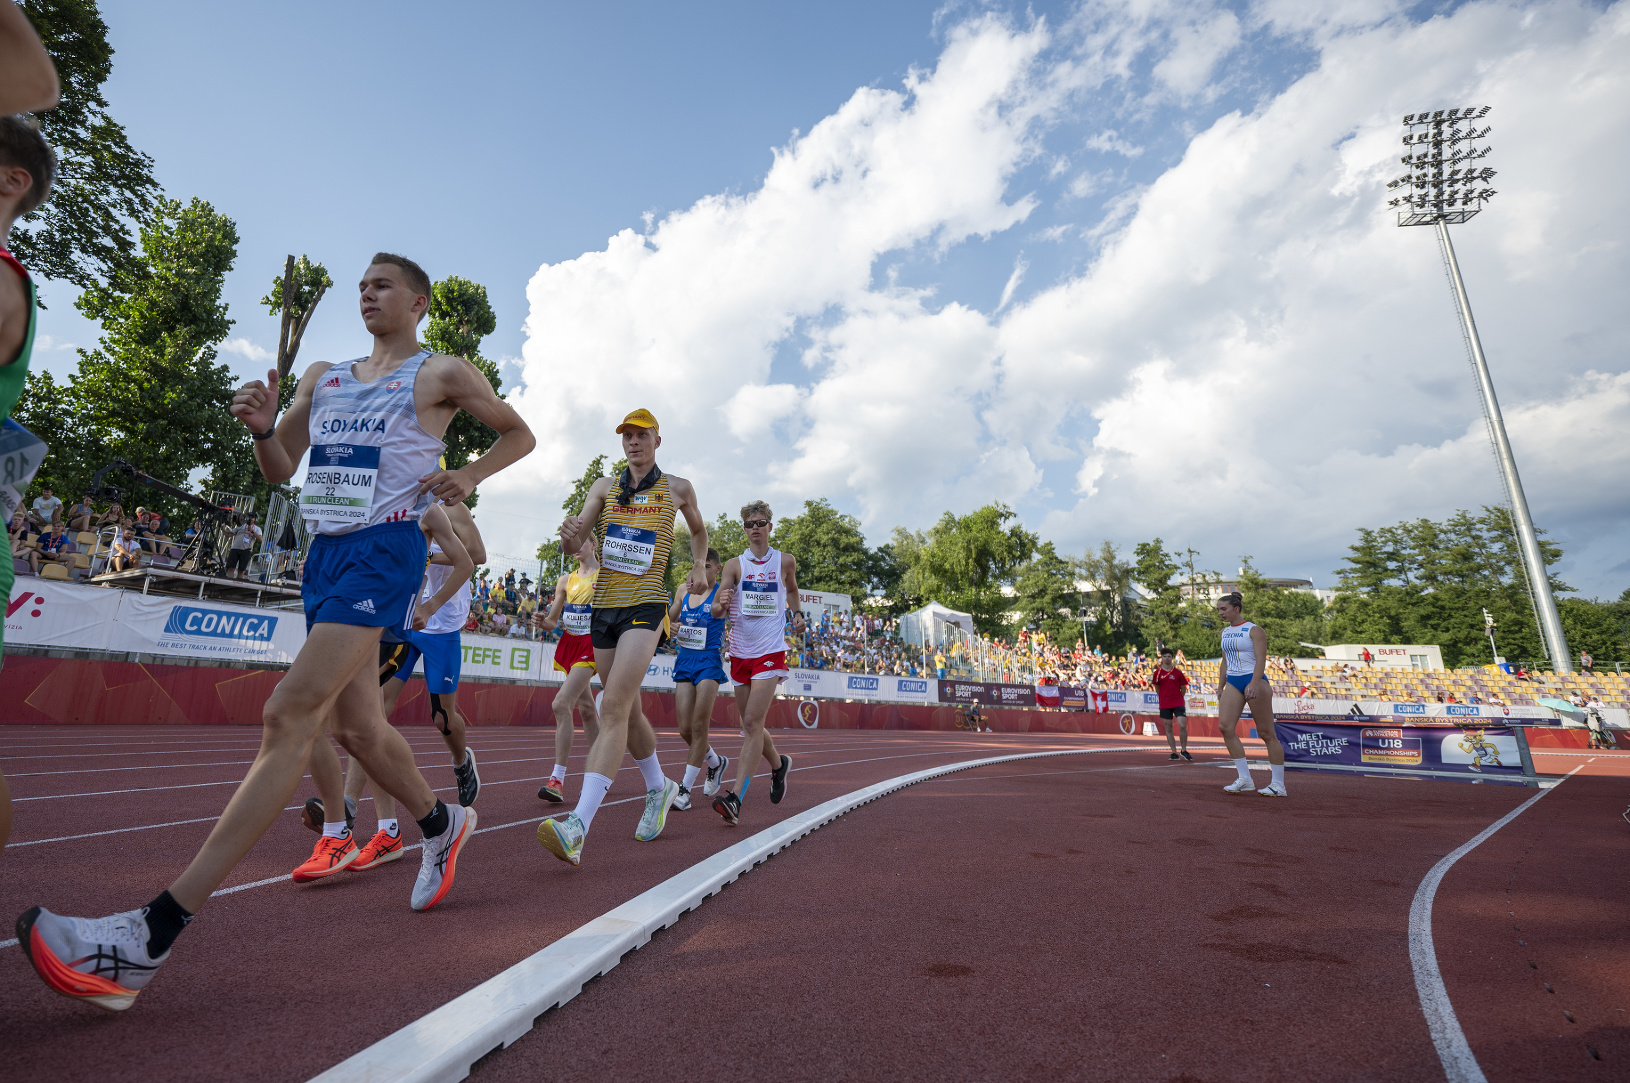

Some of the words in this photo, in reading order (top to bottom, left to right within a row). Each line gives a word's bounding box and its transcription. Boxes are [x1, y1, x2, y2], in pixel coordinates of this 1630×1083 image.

[306, 472, 372, 488] ROSENBAUM
[325, 487, 336, 496] 22
[612, 506, 664, 514] GERMANY
[604, 540, 652, 556] ROHRSSEN
[352, 604, 376, 614] adidas
[184, 612, 269, 638] CONICA
[852, 678, 878, 689] CONICA
[902, 681, 926, 692] CONICA
[1108, 692, 1126, 702] ONICA
[1398, 705, 1424, 713] CONICA
[1450, 706, 1478, 715] CONICA
[1298, 732, 1324, 742] MEET
[1288, 742, 1308, 750] THE
[1309, 738, 1349, 748] FUTURE
[1378, 739, 1402, 748] U18
[1310, 746, 1342, 756] STARS
